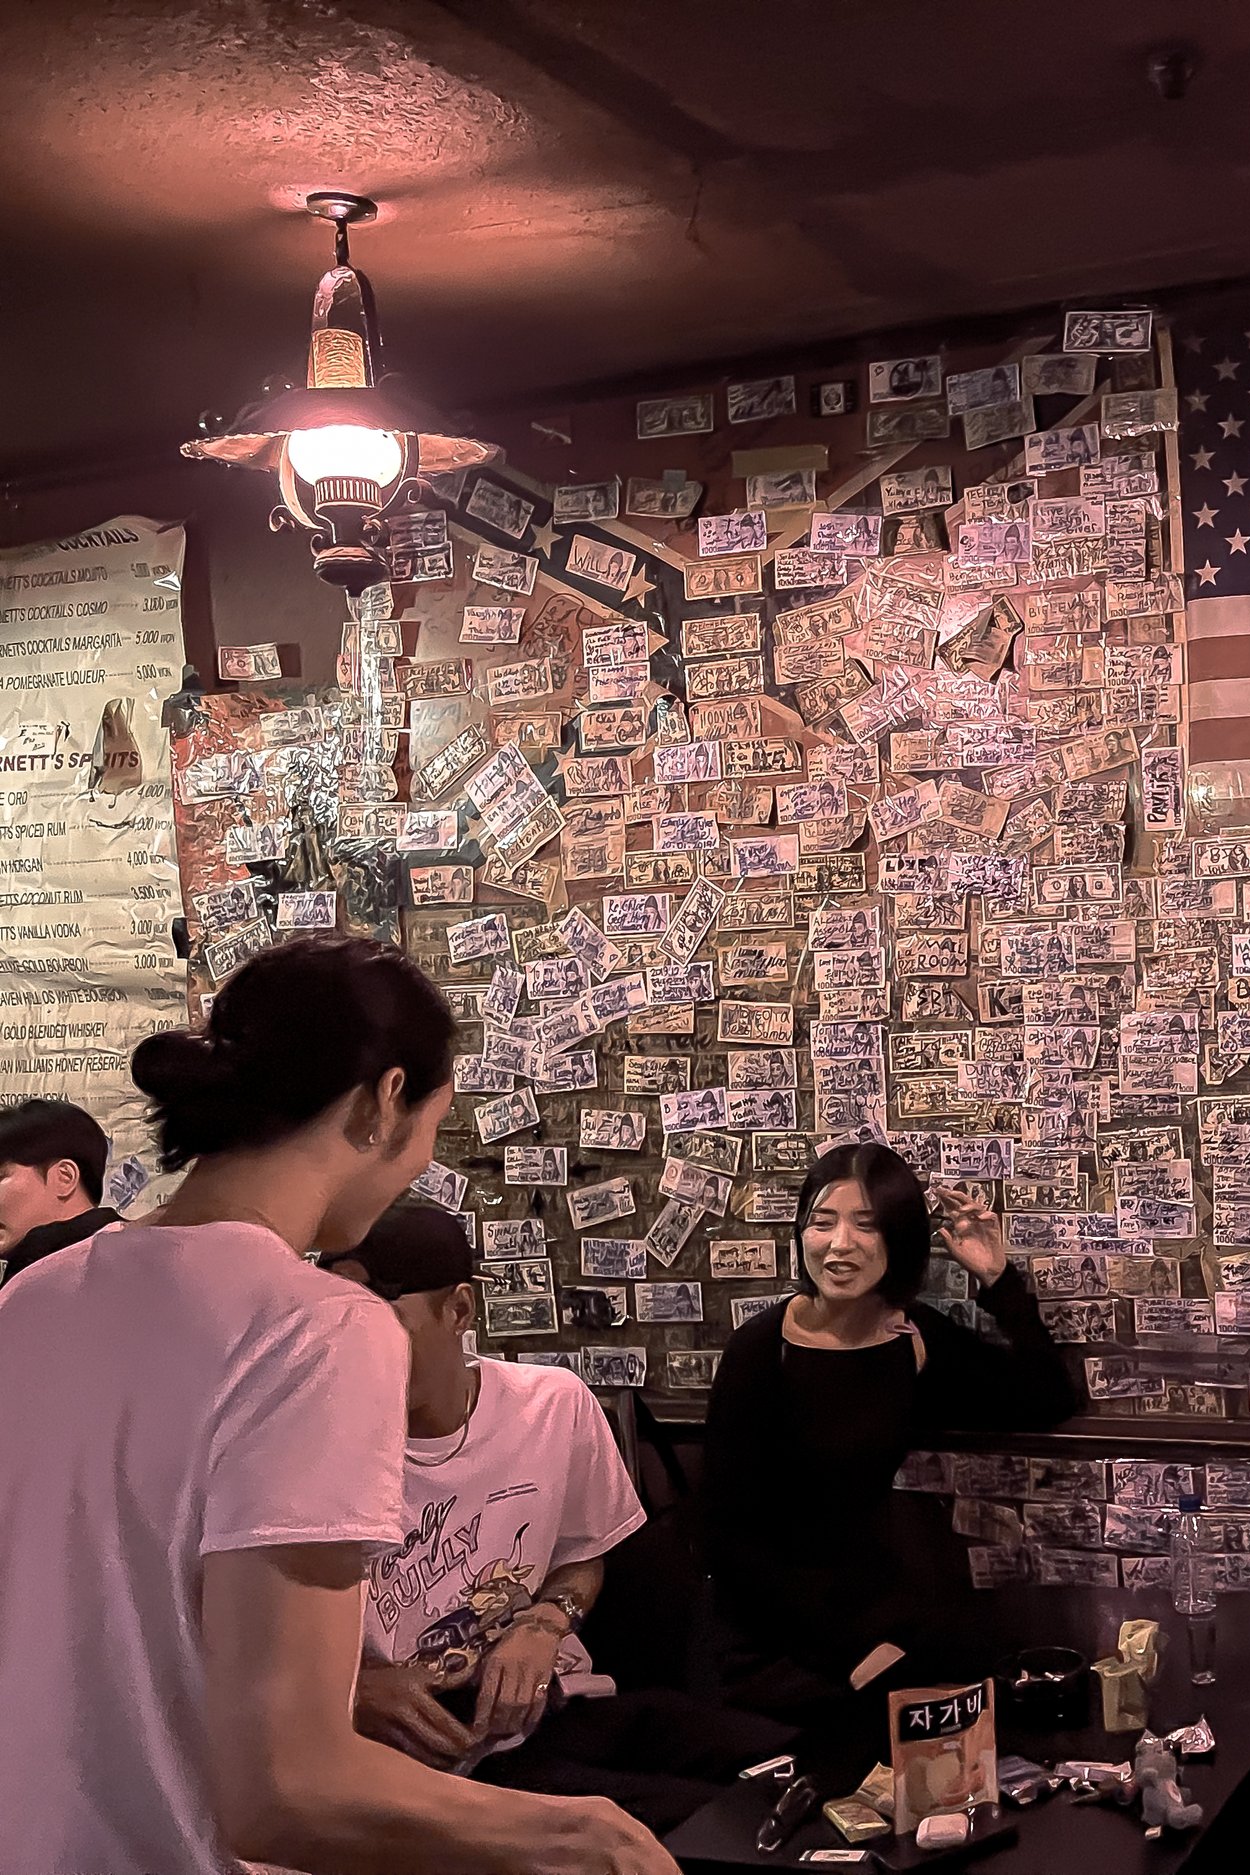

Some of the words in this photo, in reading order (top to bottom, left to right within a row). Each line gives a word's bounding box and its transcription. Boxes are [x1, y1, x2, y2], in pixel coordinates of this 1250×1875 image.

[31, 571, 76, 588] COCKTAILS
[28, 603, 74, 620] COCKTAILS
[76, 601, 107, 616] COSMO
[27, 637, 70, 656] COCKTAILS
[72, 632, 122, 651] MARGARITA
[6, 671, 66, 690] POMEGRANATE
[67, 669, 106, 686] LIQUEUR
[15, 823, 44, 839] SPICED
[47, 821, 66, 837] RUM
[18, 925, 50, 940] VANILLA
[52, 923, 81, 938] VODKA
[4, 1025, 26, 1040] GOLD
[69, 1022, 107, 1037] WHISKEY
[55, 1056, 86, 1071] HONEY
[86, 1055, 127, 1071] RESERVE
[1218, 1325, 1238, 1333] 1000
[376, 1512, 482, 1635] BULLY
[908, 1688, 983, 1731] 자가비
